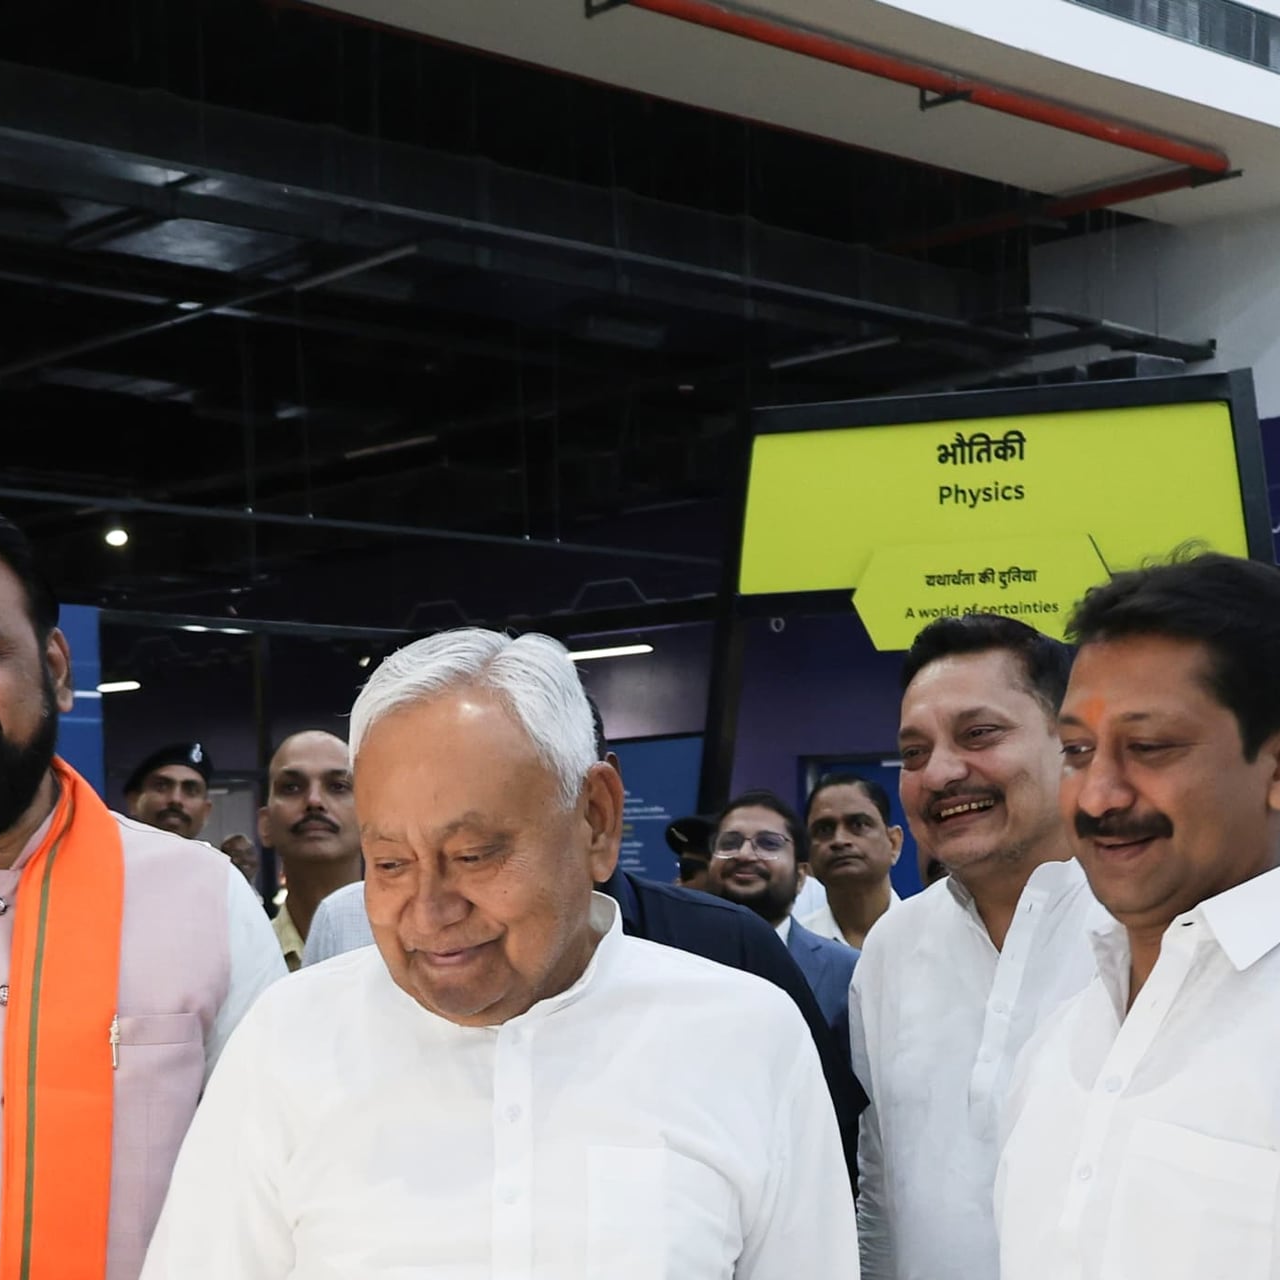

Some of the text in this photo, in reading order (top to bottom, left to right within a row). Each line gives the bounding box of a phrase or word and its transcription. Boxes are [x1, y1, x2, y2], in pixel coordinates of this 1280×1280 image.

[937, 430, 1026, 465] भौतिकी
[939, 481, 1025, 508] Physics
[978, 568, 995, 584] की
[998, 566, 1037, 589] दुनिया
[905, 600, 1059, 619] A world of certainties
